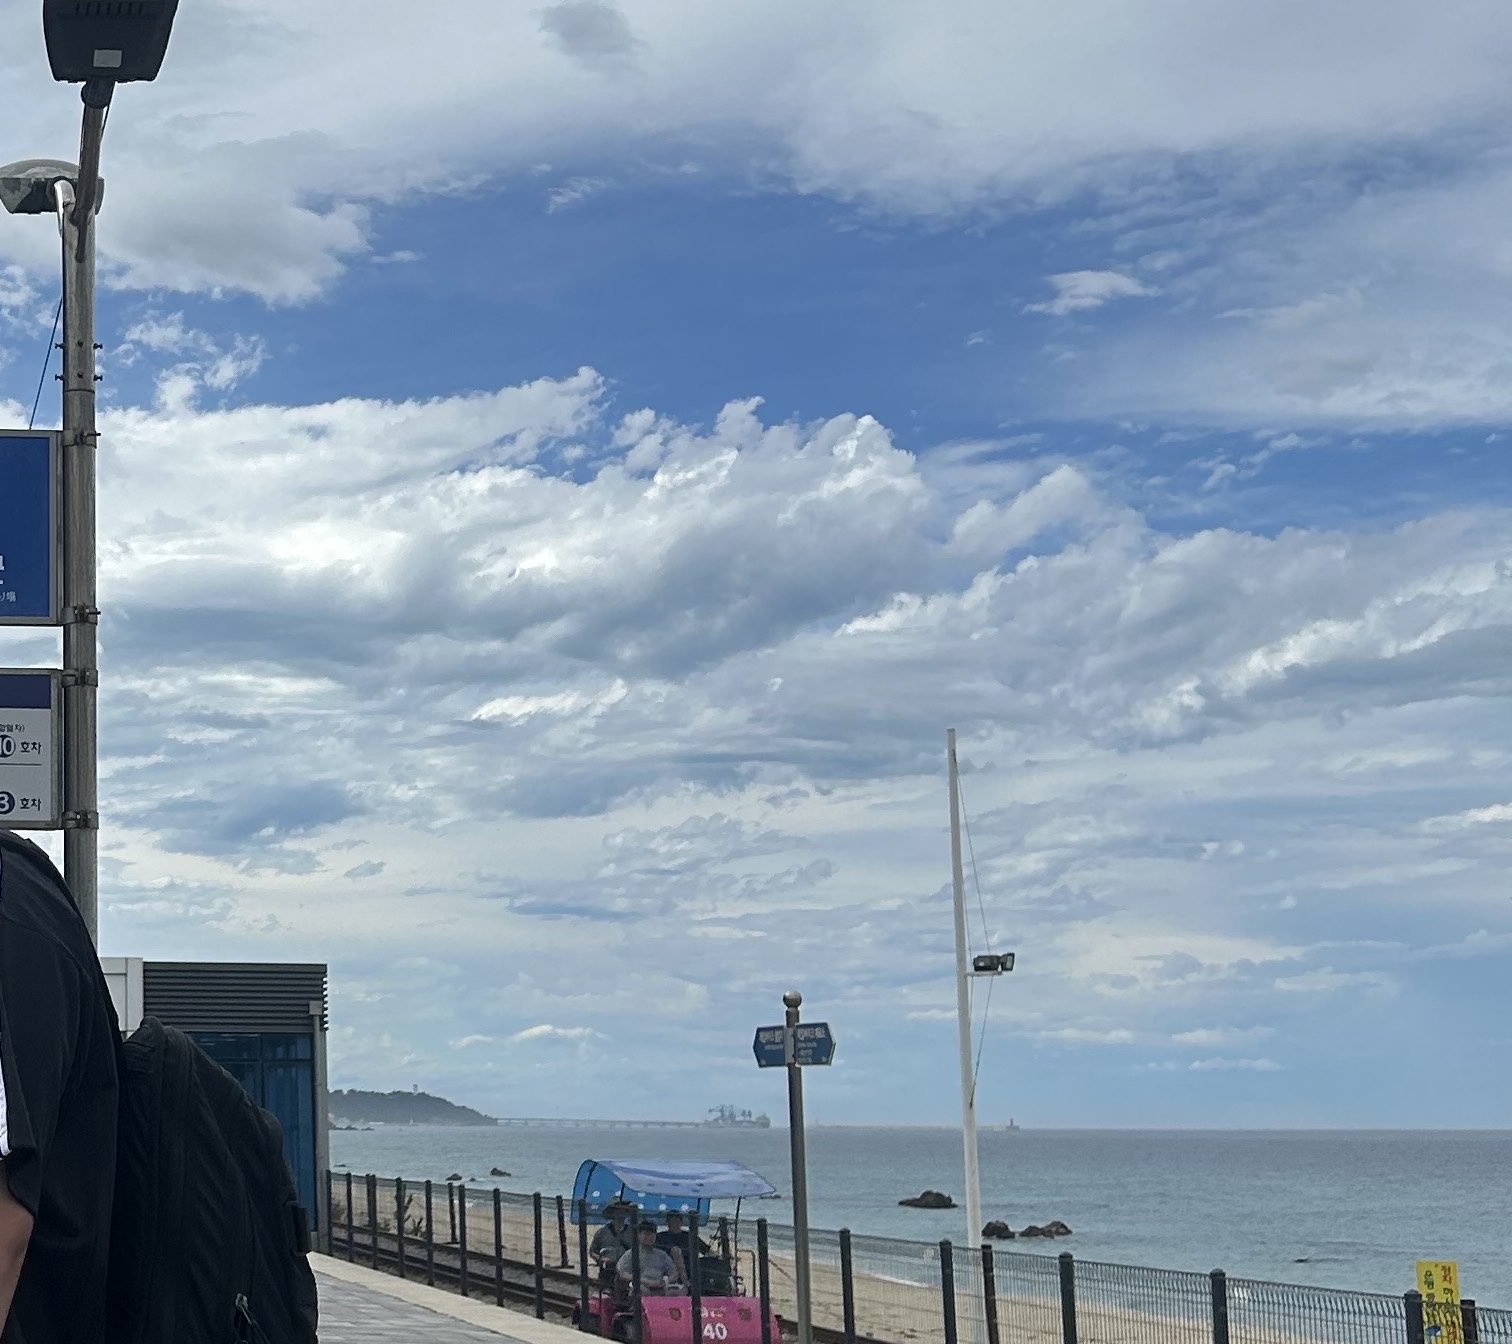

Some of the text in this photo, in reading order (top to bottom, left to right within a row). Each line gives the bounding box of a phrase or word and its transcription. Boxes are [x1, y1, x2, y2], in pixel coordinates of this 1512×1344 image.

[20, 741, 42, 755] 호차
[20, 797, 42, 812] 호차
[703, 1322, 728, 1340] 40
